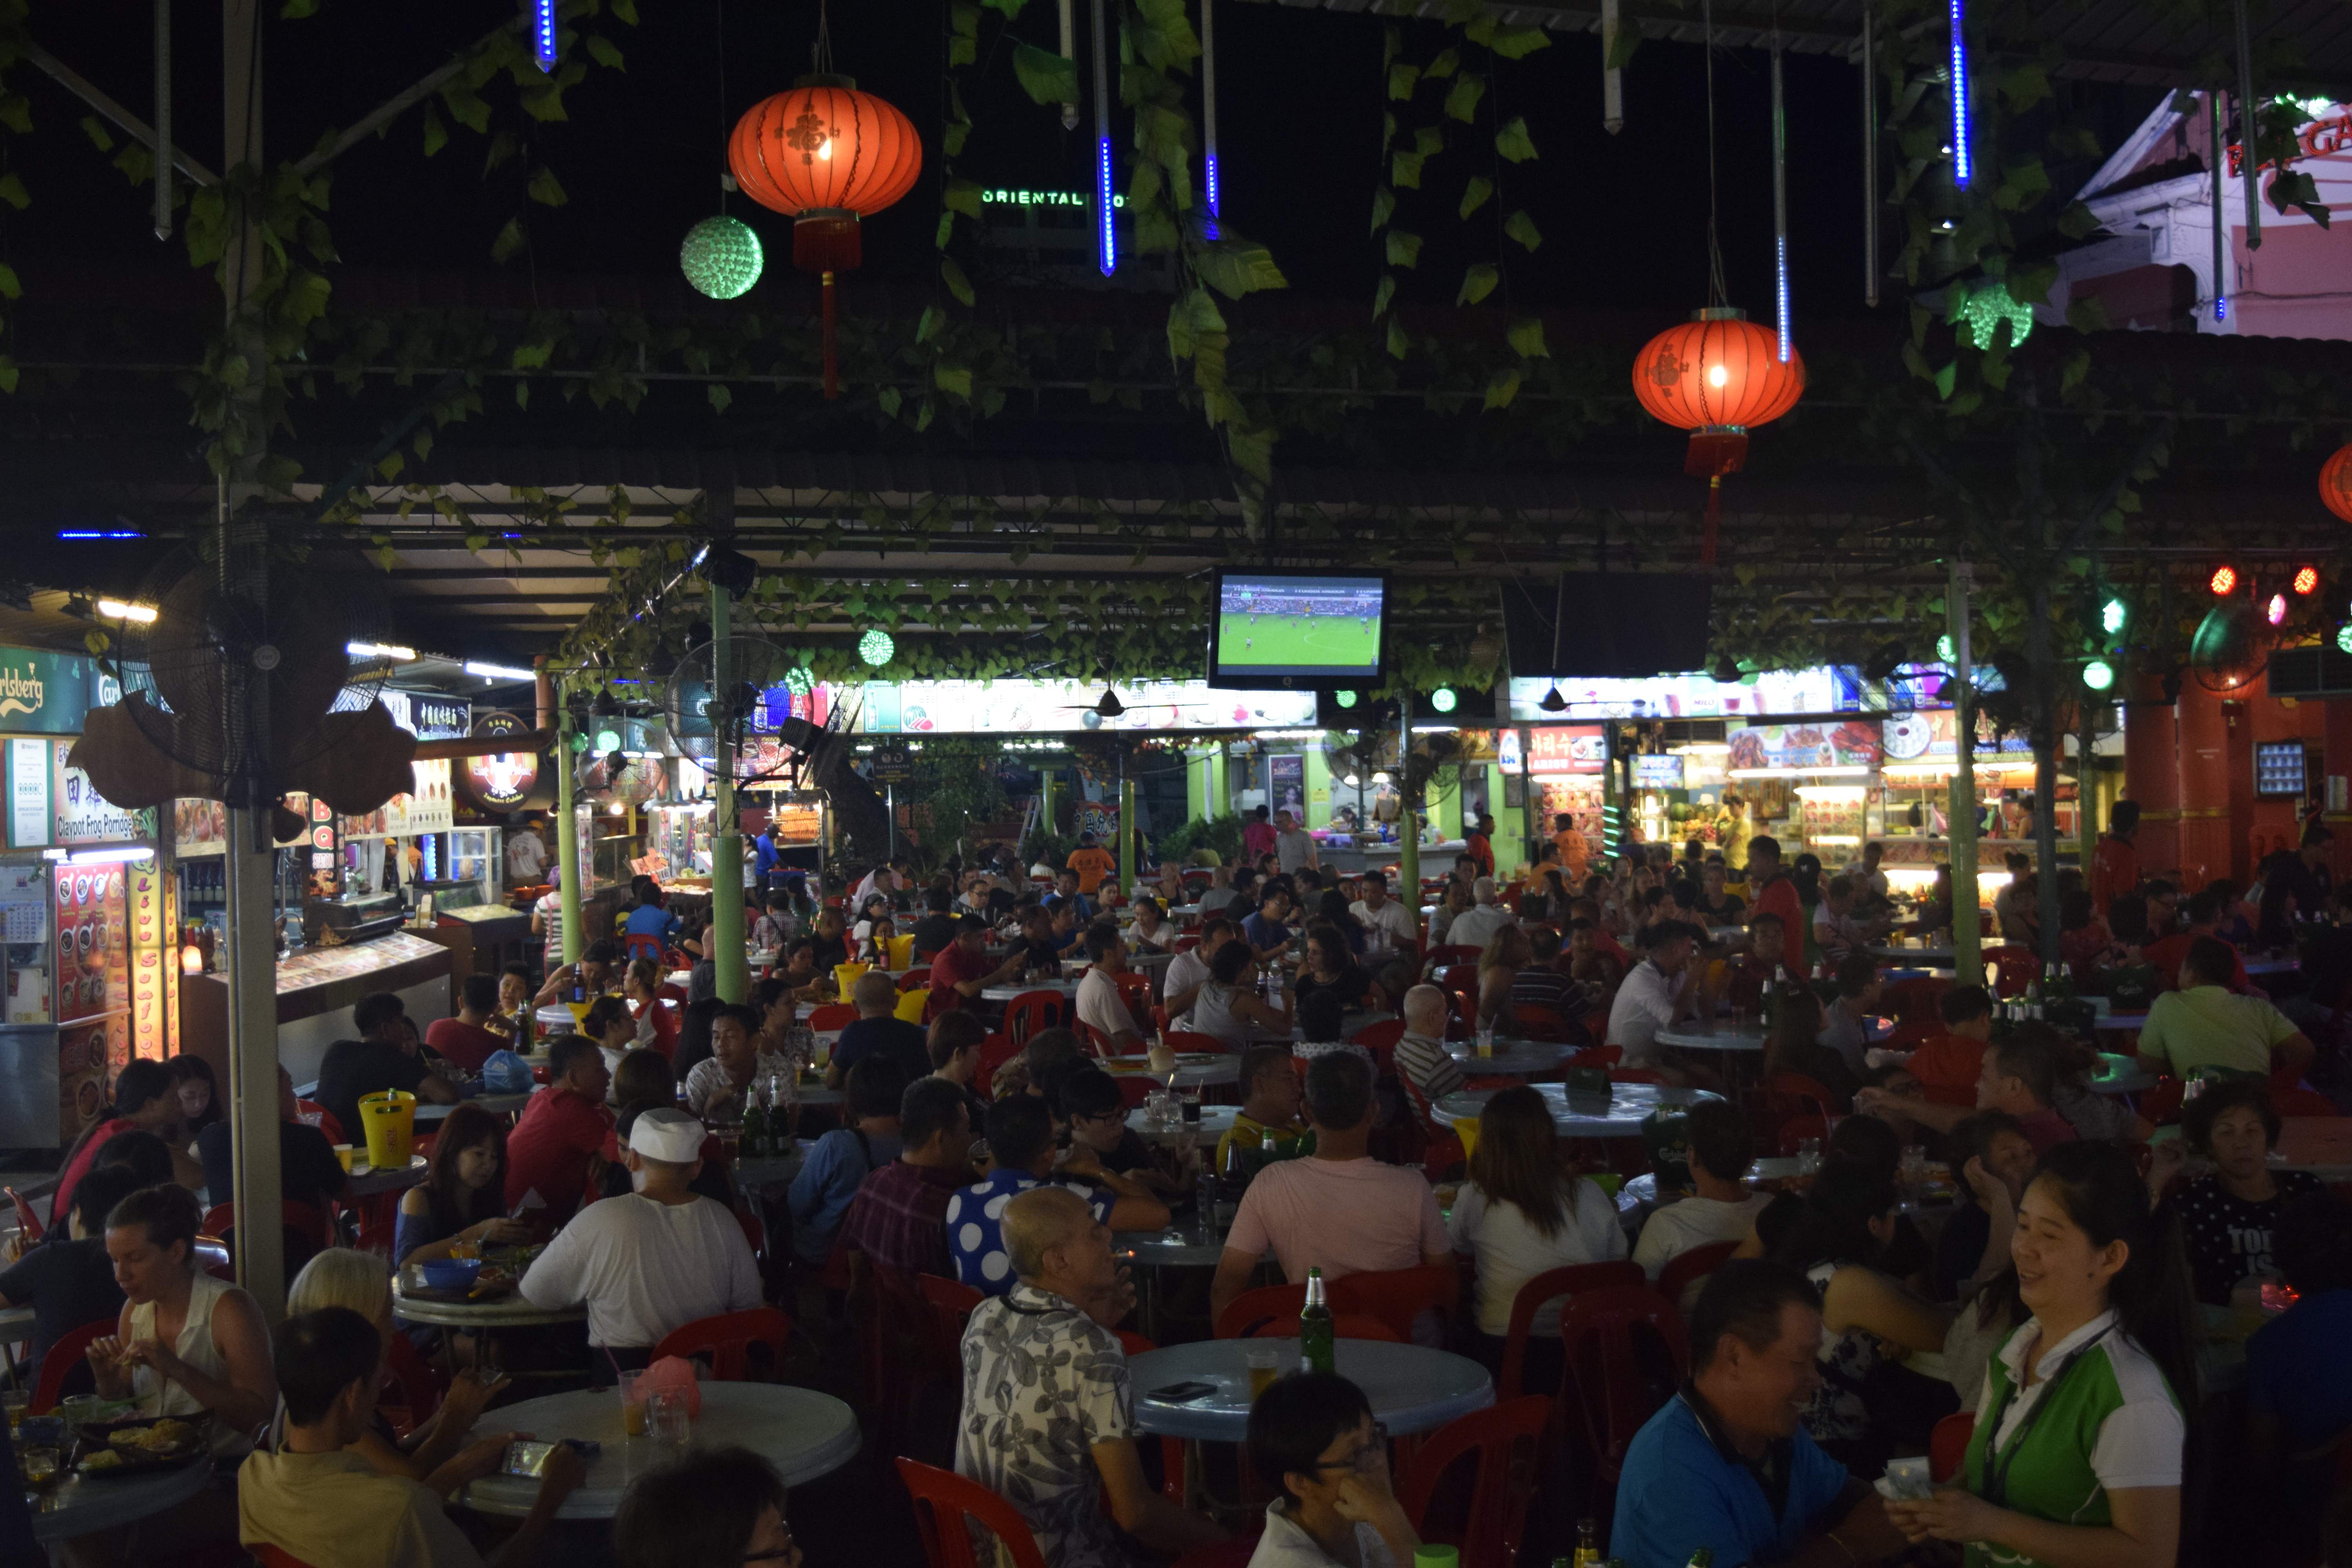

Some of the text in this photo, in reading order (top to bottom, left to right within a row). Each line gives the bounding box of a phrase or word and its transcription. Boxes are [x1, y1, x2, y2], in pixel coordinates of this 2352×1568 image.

[982, 190, 1083, 205] ORIENTAL
[58, 813, 132, 841] Claypot Frog Porridge
[313, 853, 334, 869] STATION
[387, 1127, 396, 1153] SKOL
